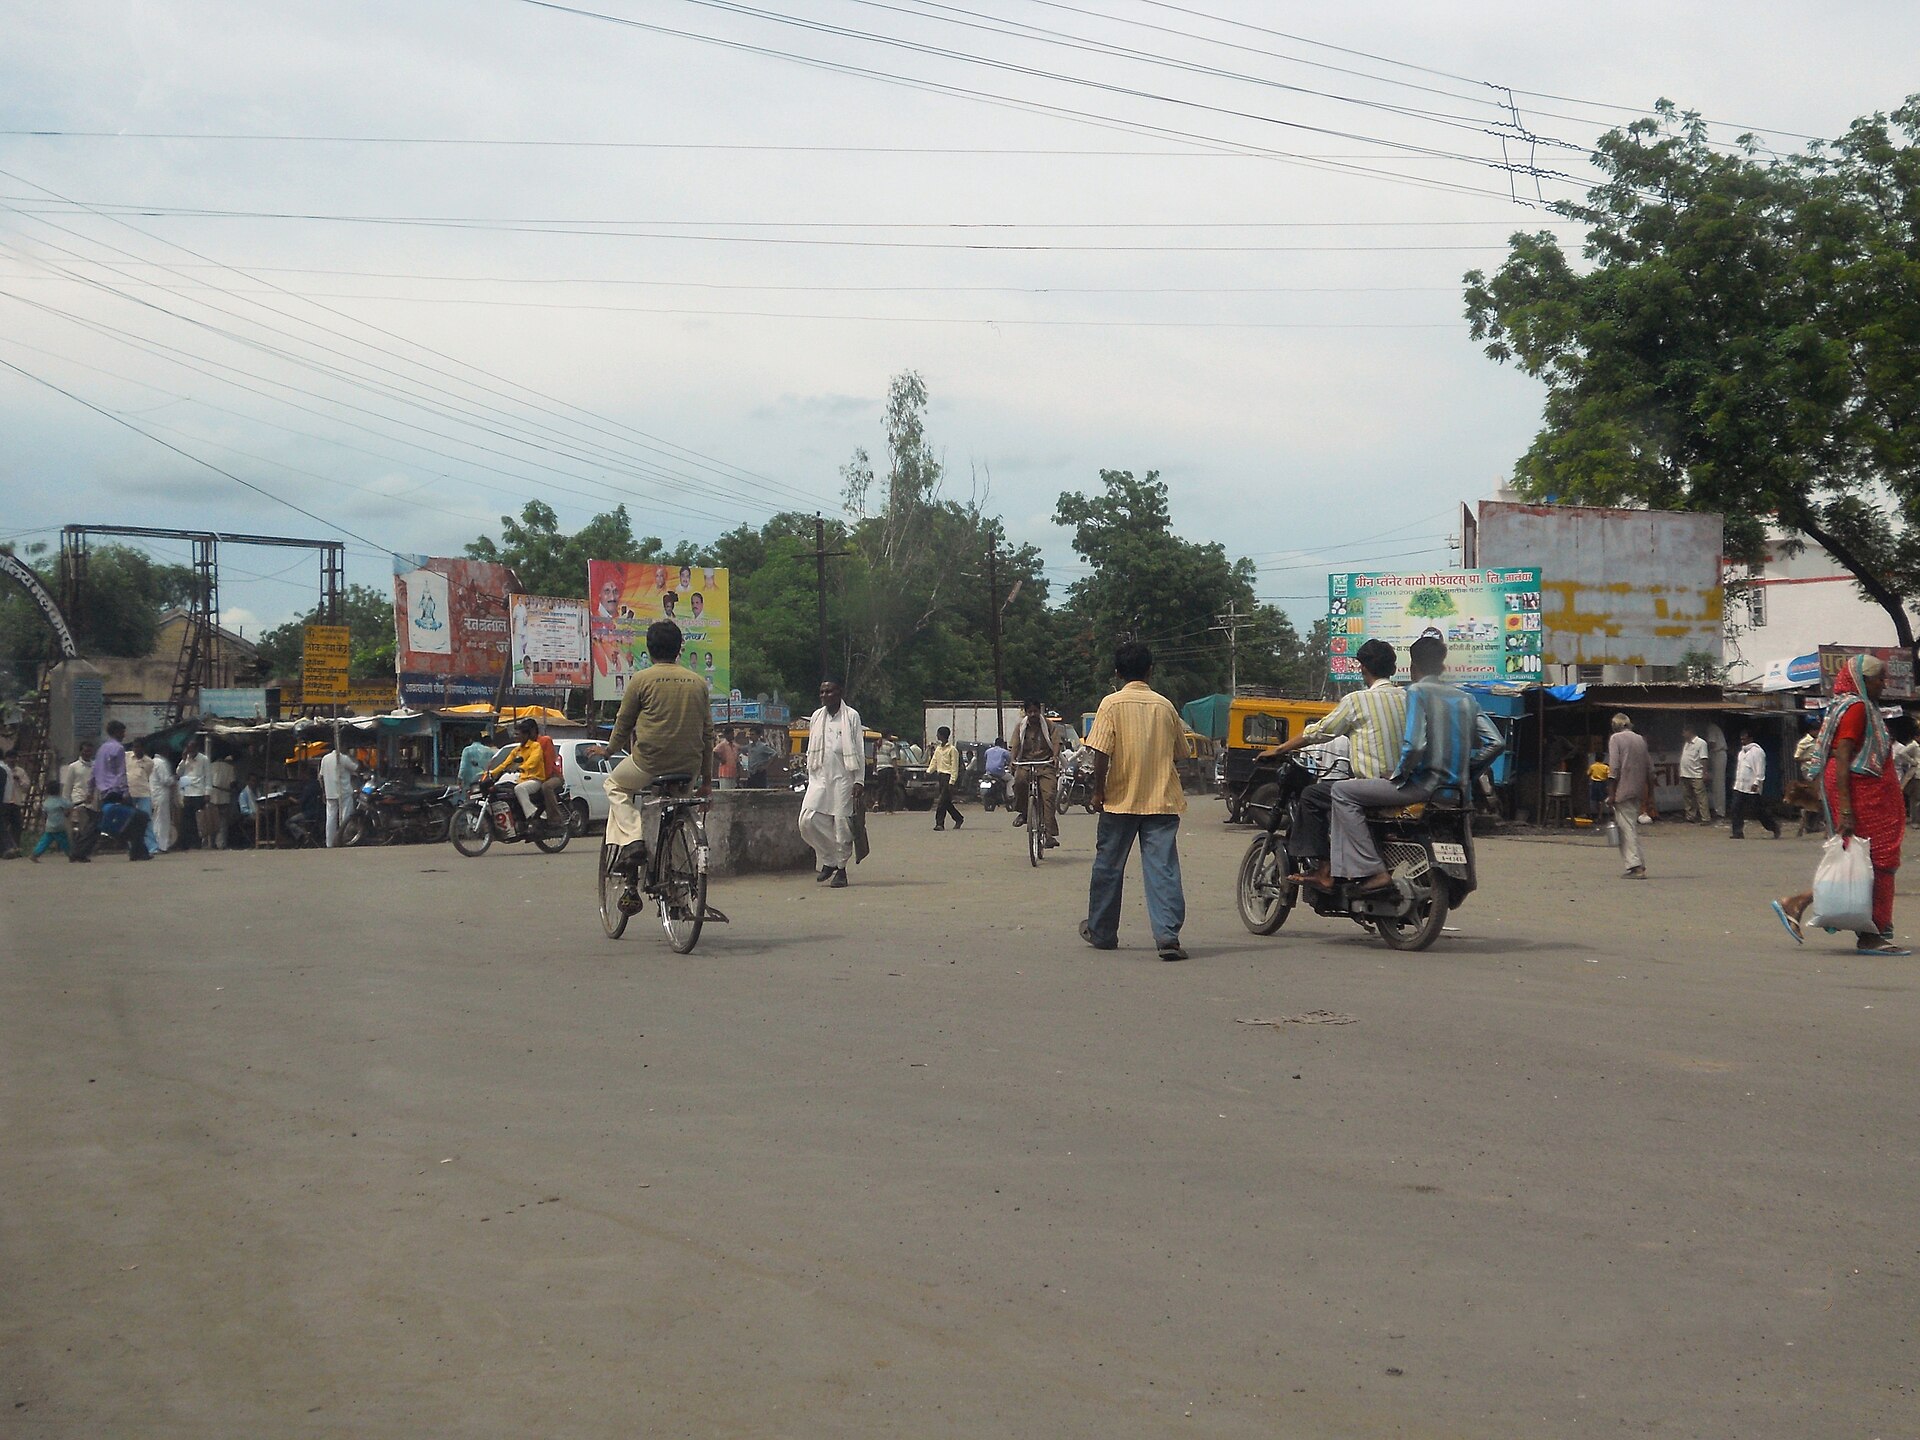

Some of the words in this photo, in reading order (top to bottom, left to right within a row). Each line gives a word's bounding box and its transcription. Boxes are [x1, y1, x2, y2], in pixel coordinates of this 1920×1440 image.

[1356, 575, 1374, 587] ग्रीन
[1470, 575, 1483, 584] प्रा.
[1487, 571, 1503, 583] लि.
